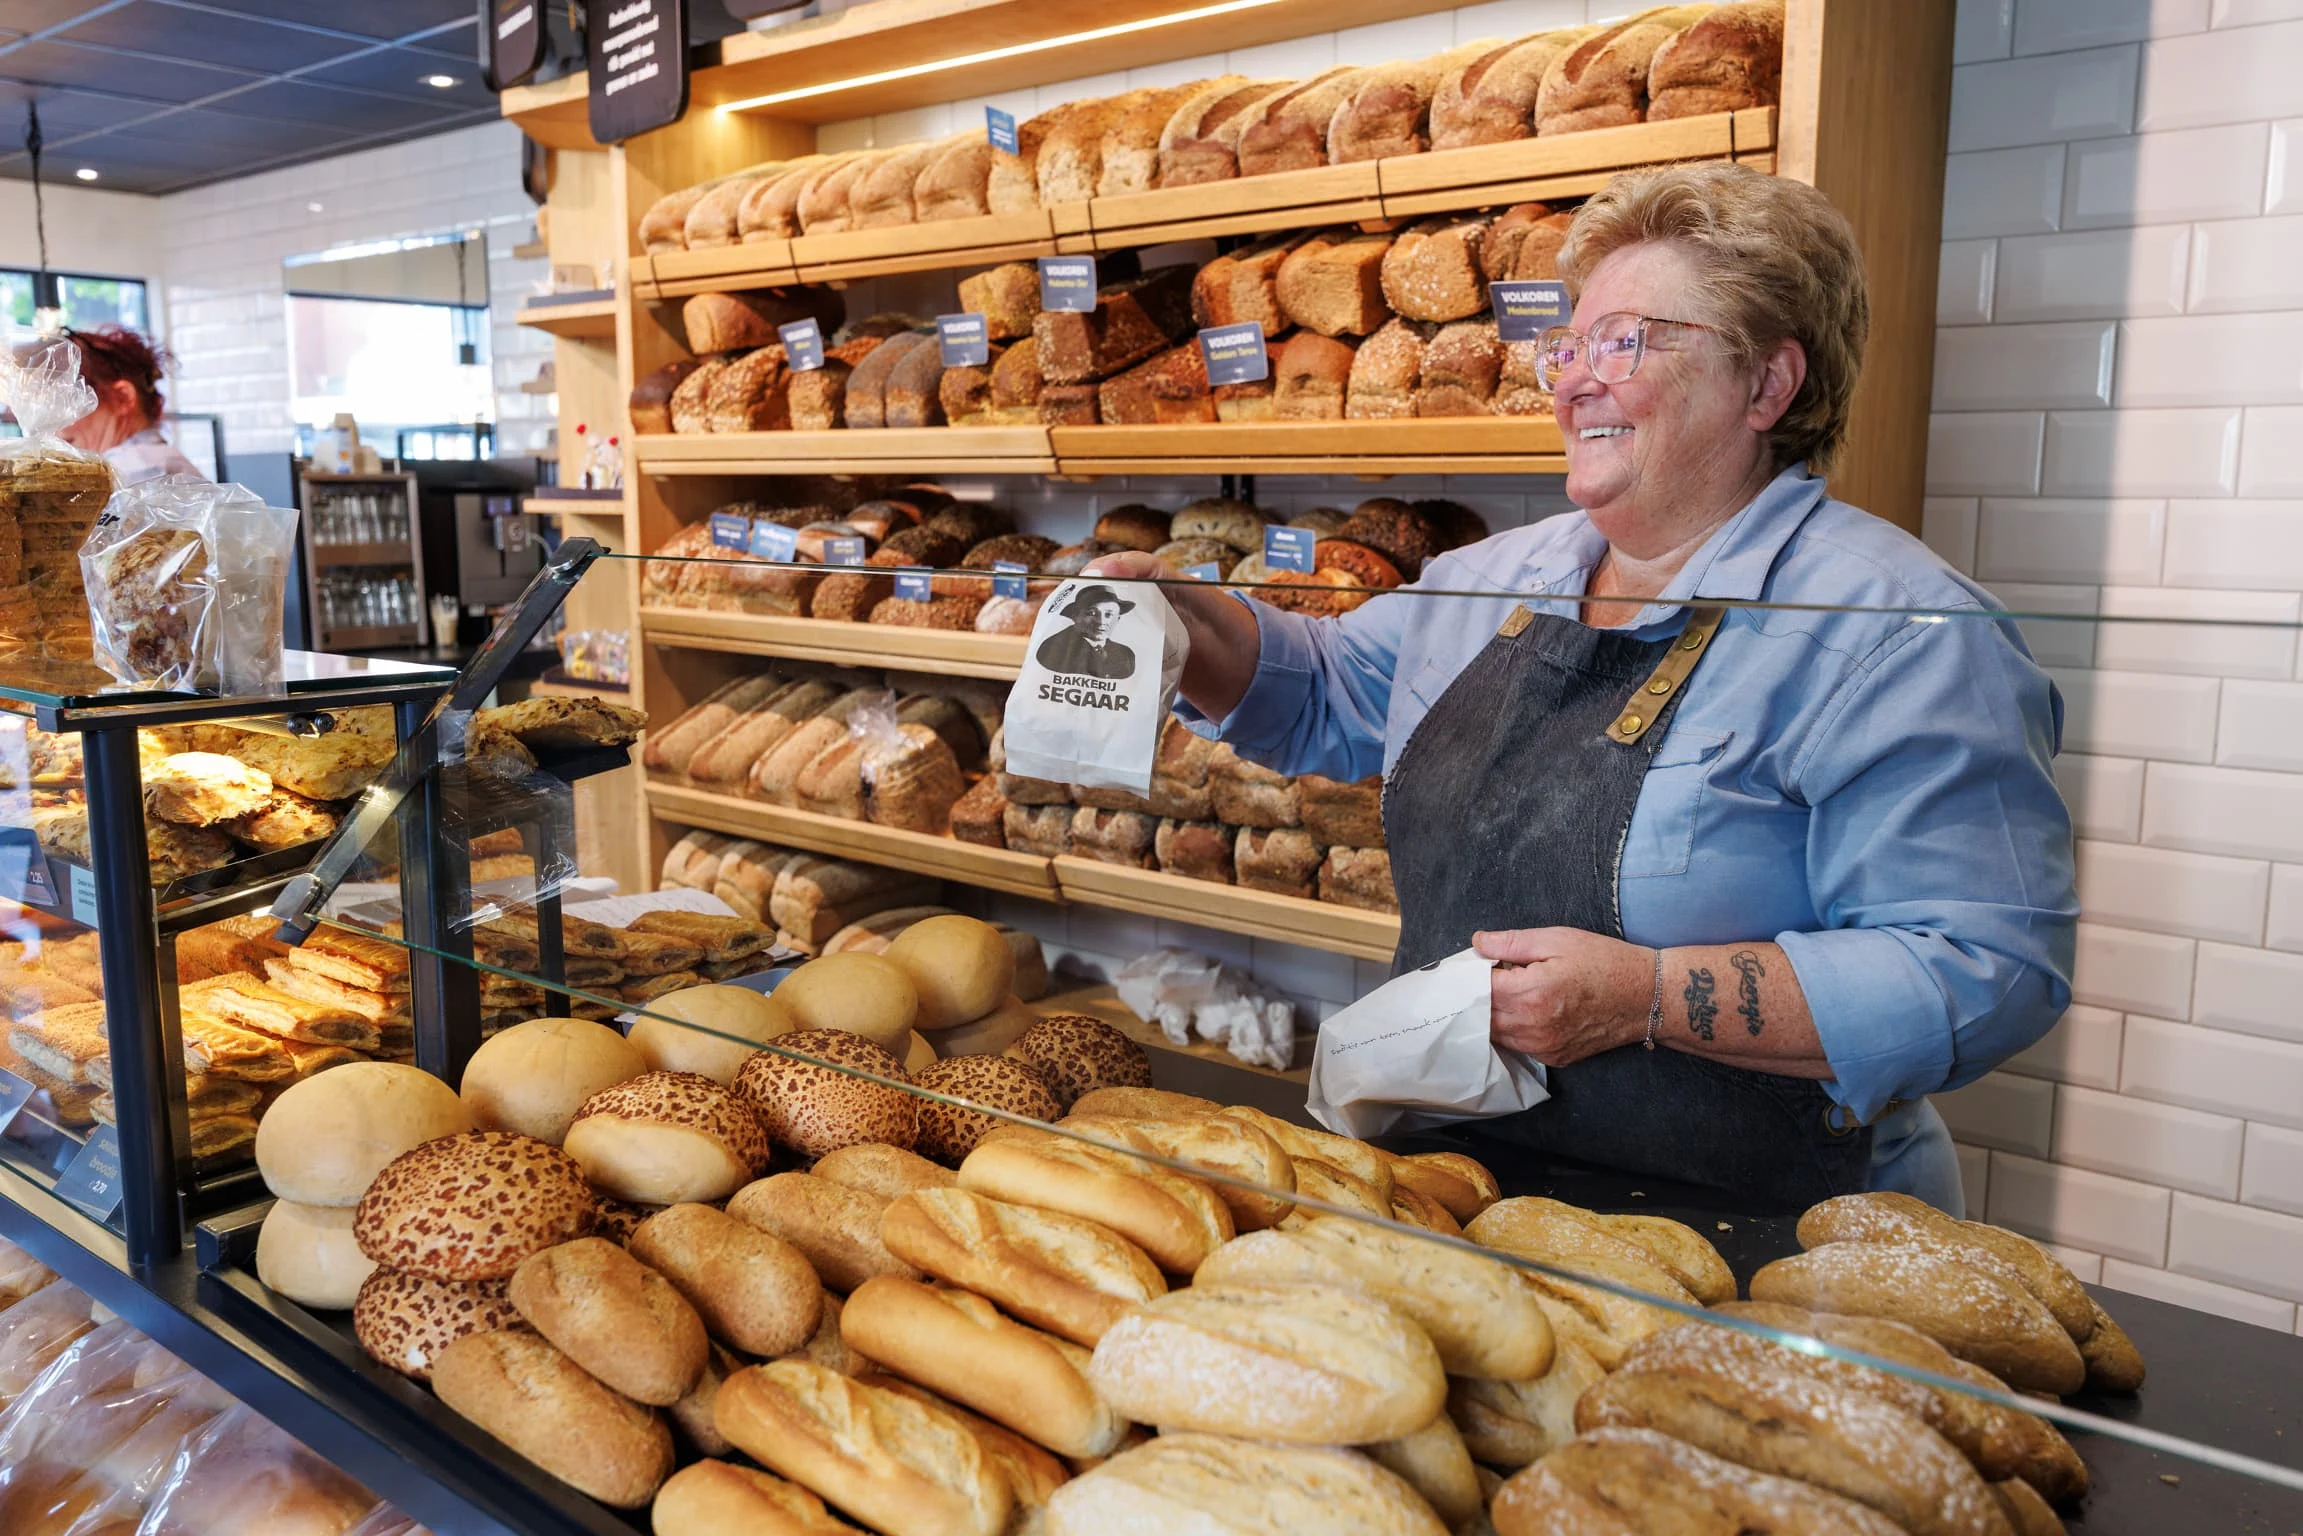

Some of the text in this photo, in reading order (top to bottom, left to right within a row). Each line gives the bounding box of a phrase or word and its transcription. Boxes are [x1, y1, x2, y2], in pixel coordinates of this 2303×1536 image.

[1501, 290, 1560, 303] VOLKOREN
[1053, 674, 1117, 692] BAKKERIJ
[1038, 684, 1130, 712] SEGAAR
